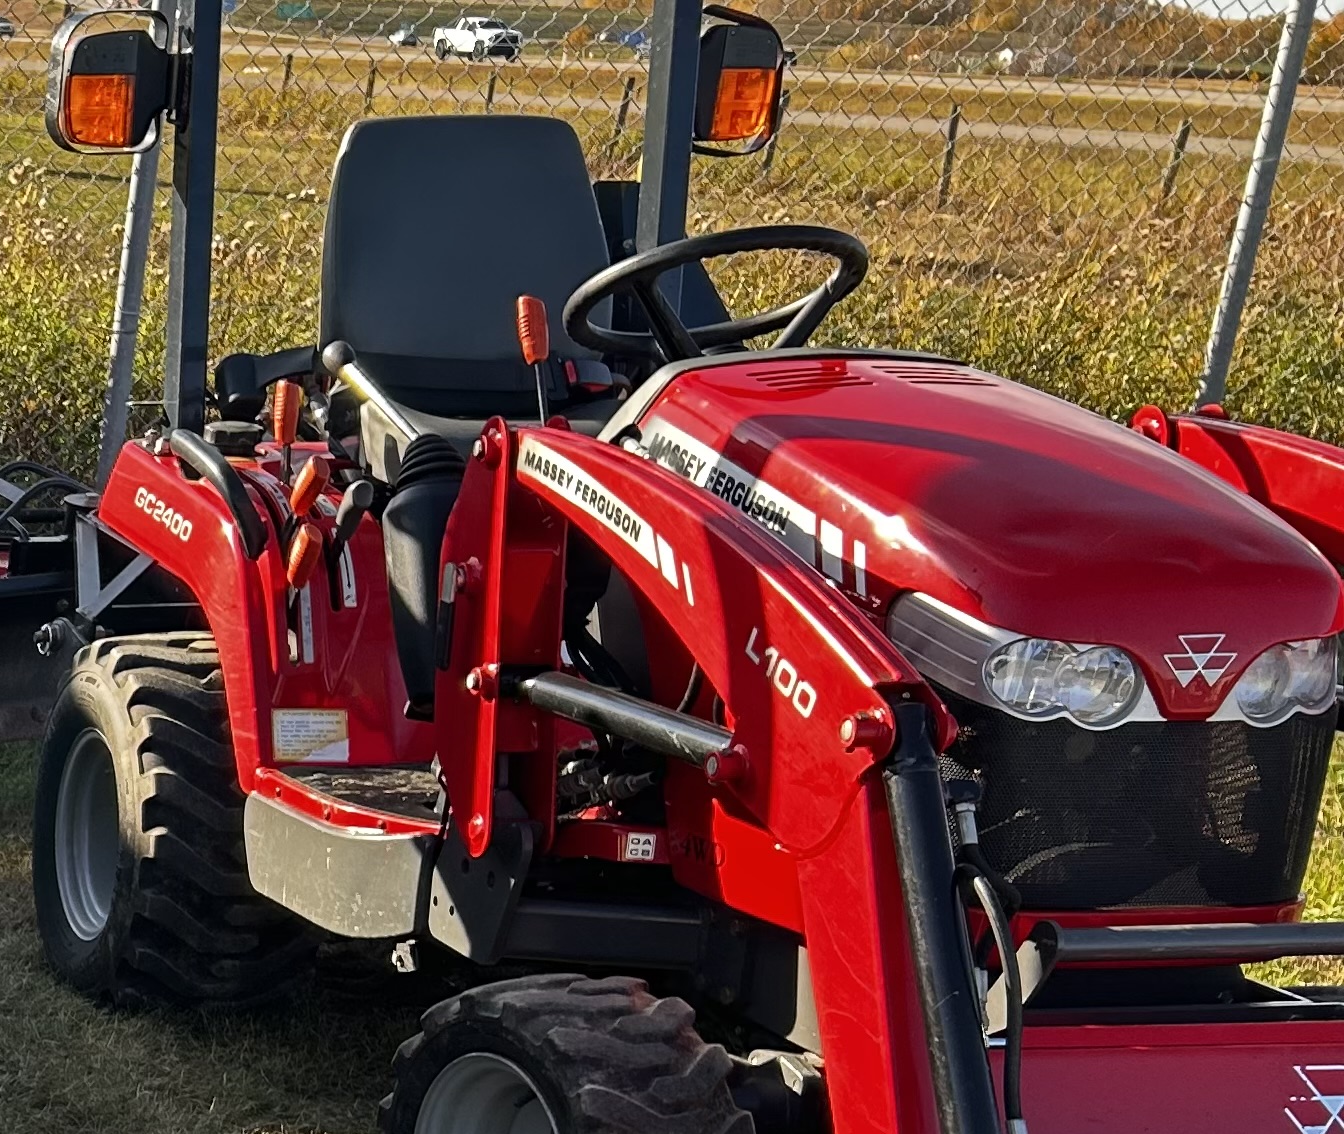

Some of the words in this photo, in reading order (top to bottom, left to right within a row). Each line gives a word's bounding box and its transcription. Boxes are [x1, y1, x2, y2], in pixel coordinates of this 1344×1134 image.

[134, 486, 193, 542] GC2400
[524, 449, 574, 490] MASSEY
[574, 479, 642, 542] FERGUSON
[649, 433, 707, 481] MASSEY
[704, 466, 790, 530] FERGUSON
[745, 626, 817, 719] L100
